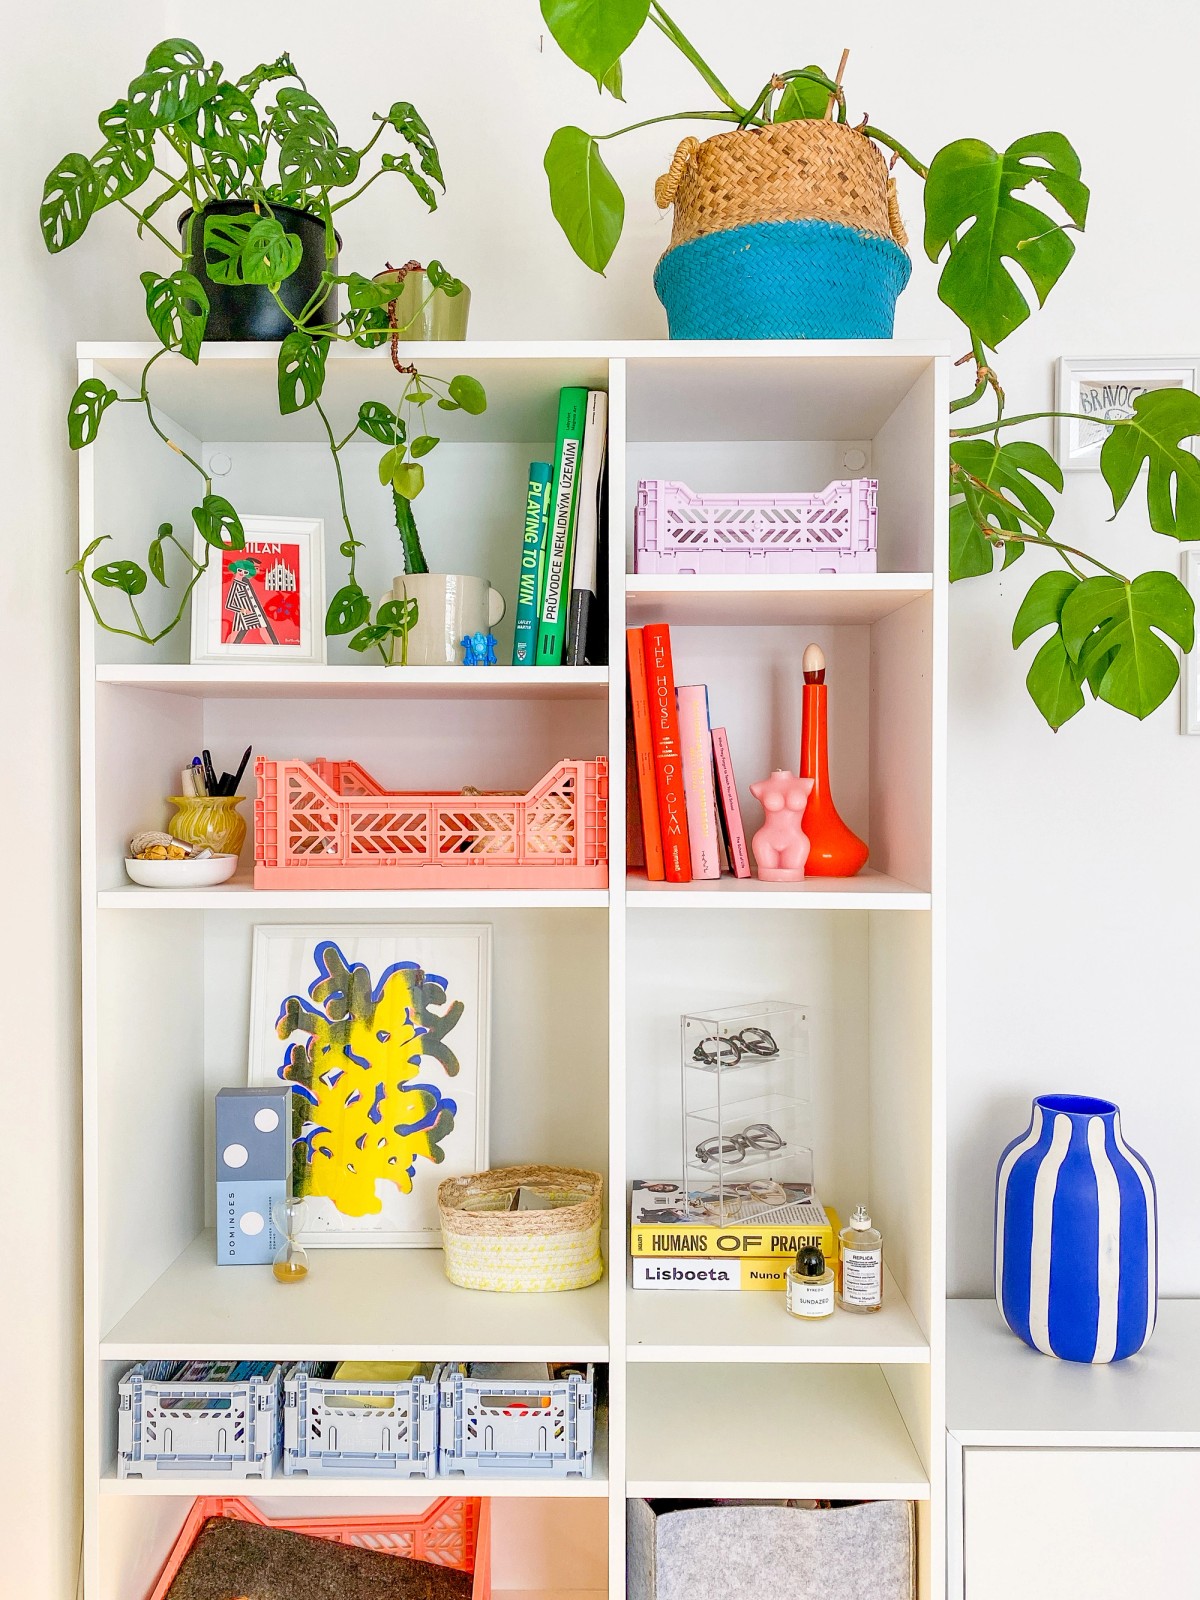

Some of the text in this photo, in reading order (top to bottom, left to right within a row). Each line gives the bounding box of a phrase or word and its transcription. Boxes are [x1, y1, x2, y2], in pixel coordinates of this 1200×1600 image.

[519, 481, 542, 606] PLAYING TO WIN
[545, 442, 577, 620] PRŮVODCE NEKLIDNÝM ÚZEMÍM
[654, 636, 665, 668] THE
[656, 676, 670, 729] HOUSE
[664, 764, 674, 786] OF
[666, 792, 681, 836] GLAM
[652, 1234, 708, 1252] HUMANS
[716, 1235, 762, 1252] OF
[771, 1236, 822, 1252] PRAGUE
[645, 1268, 730, 1281] Lisboeta
[750, 1271, 780, 1280] Nuno
